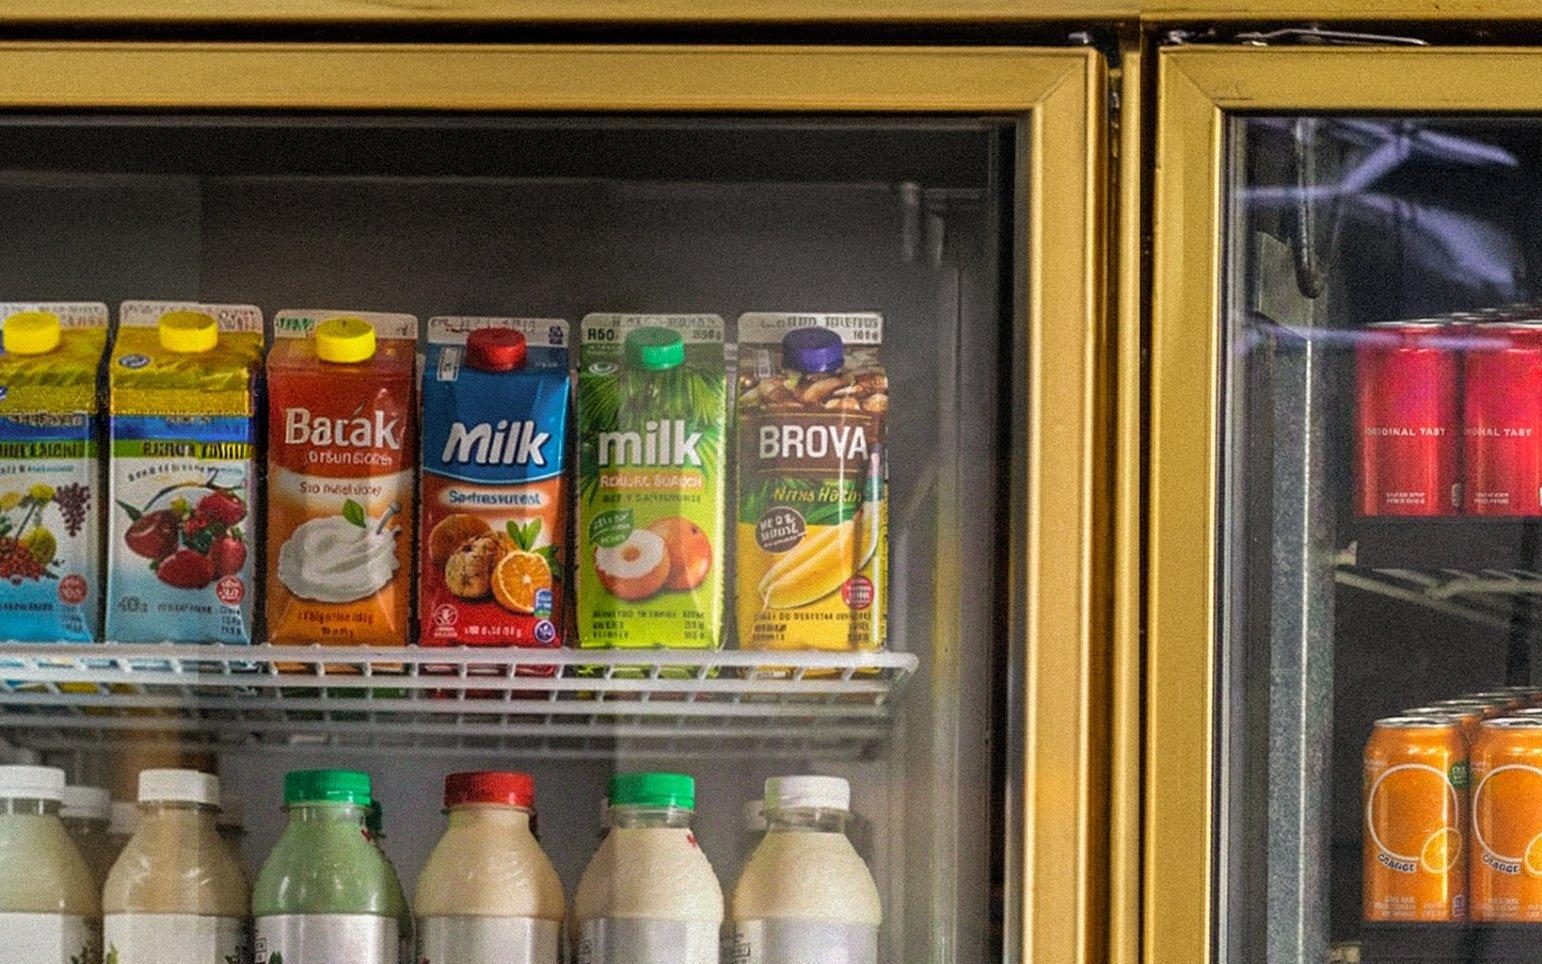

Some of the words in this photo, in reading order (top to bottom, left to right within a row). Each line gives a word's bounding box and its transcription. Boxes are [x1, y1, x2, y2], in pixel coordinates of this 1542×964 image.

[442, 420, 552, 466] Milk
[600, 419, 702, 466] milk
[758, 424, 869, 460] BROVA
